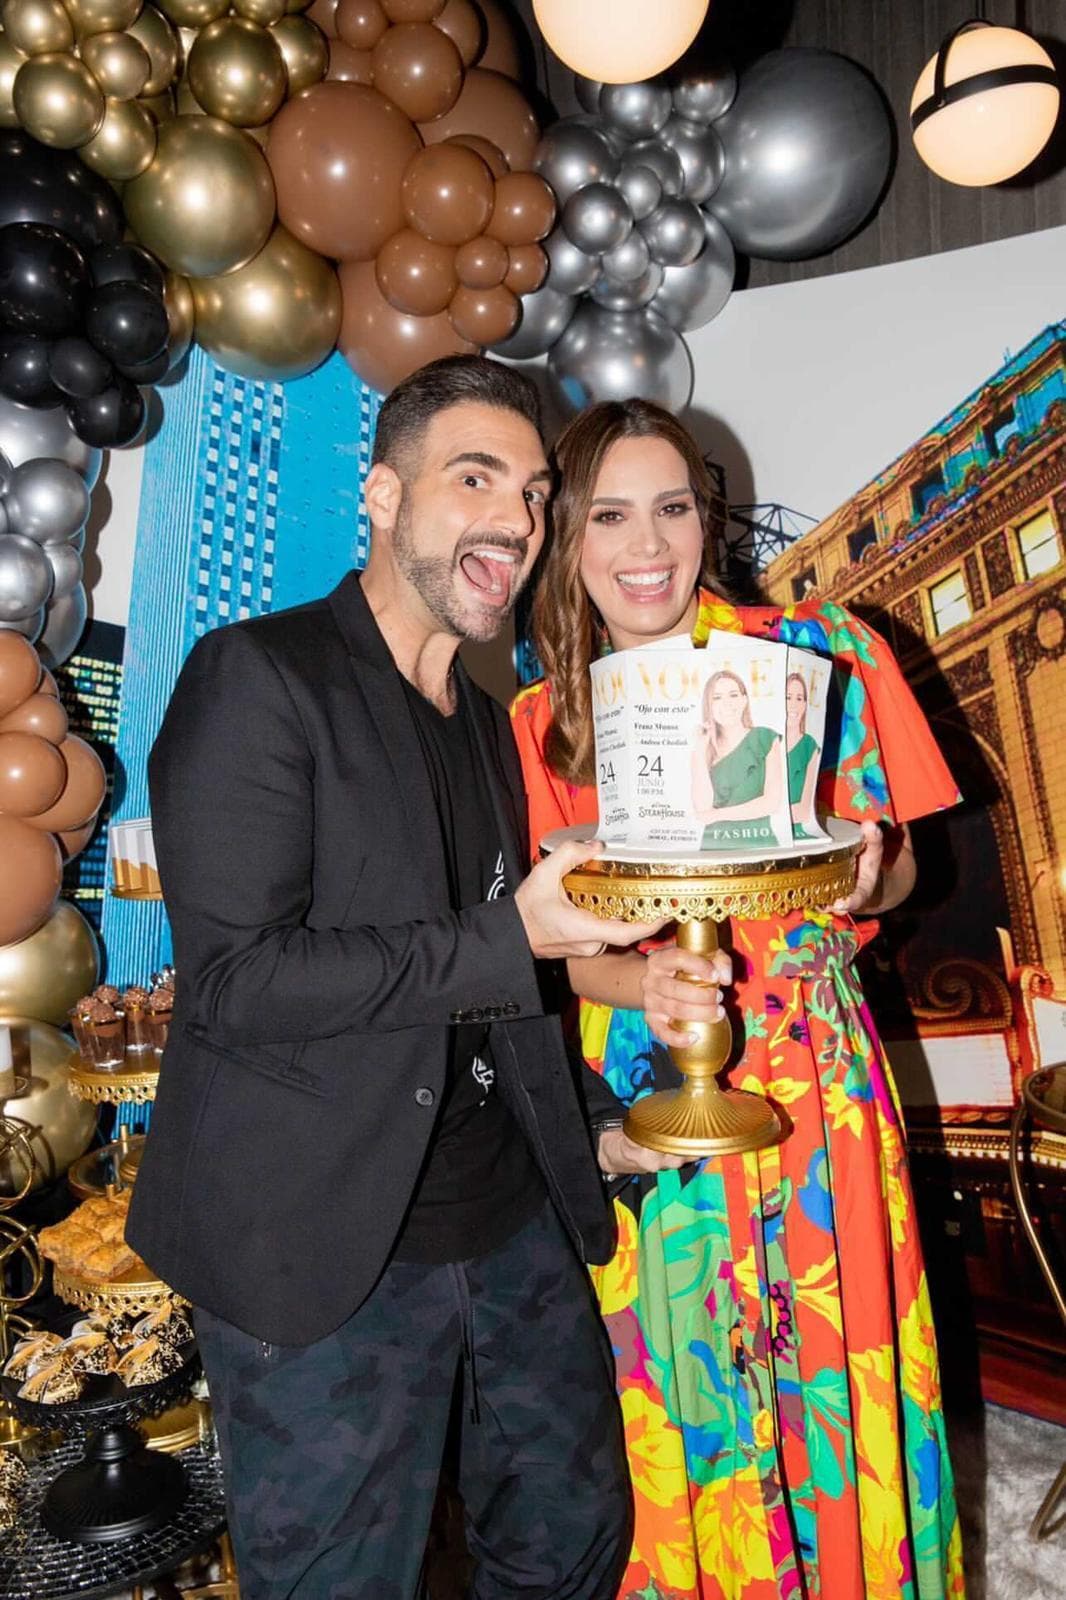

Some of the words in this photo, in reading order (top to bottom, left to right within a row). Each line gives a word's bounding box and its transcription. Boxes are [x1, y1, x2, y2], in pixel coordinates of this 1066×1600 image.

[600, 760, 616, 785] 24
[637, 754, 664, 777] 24
[713, 827, 774, 841] FASHIO
